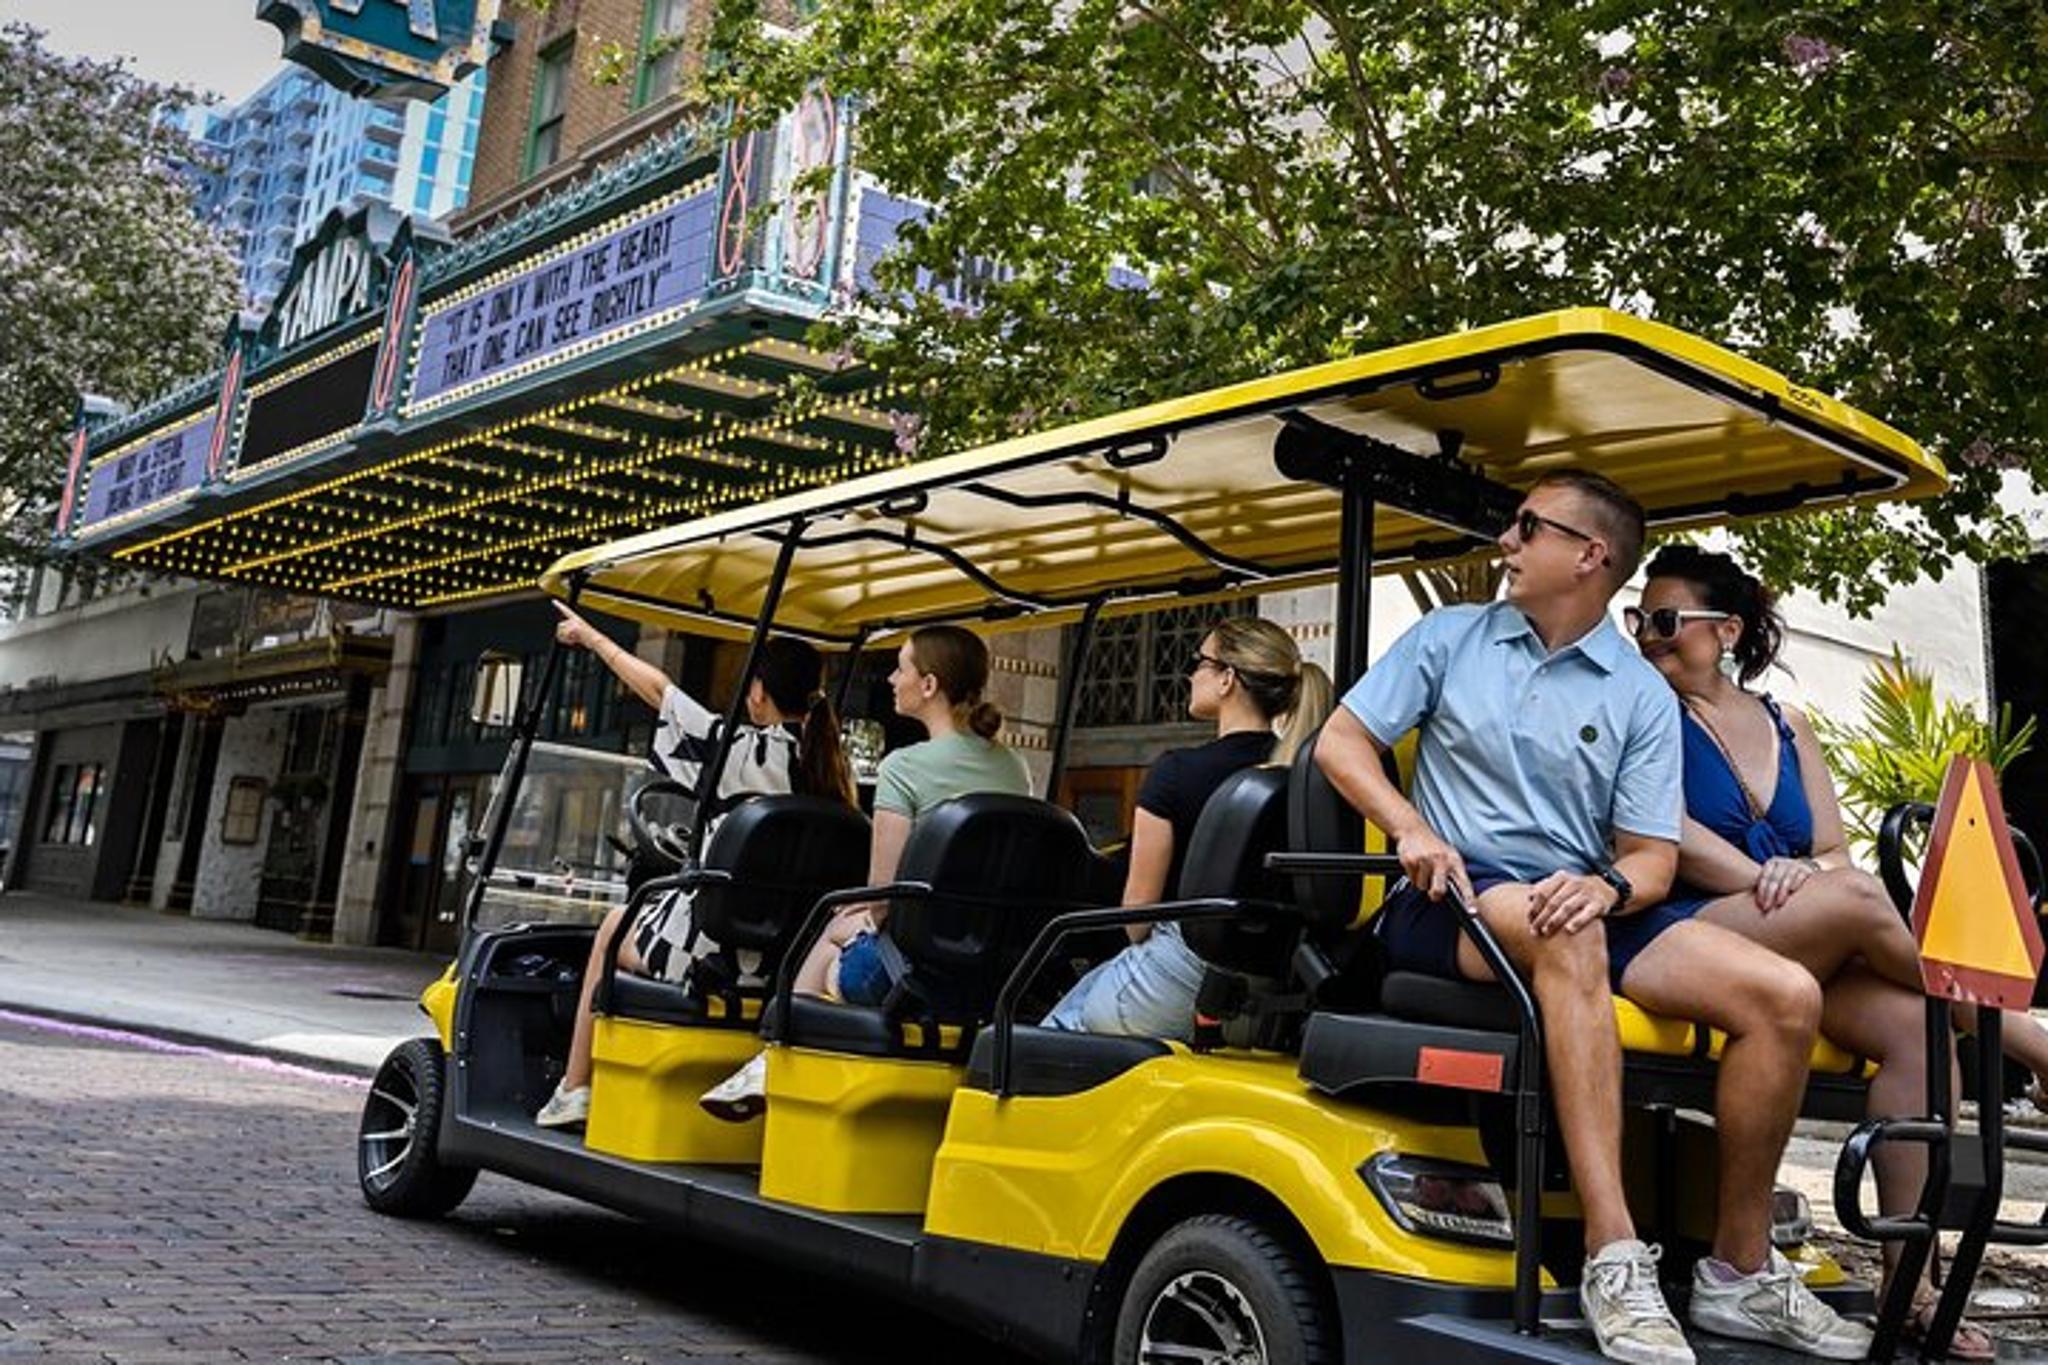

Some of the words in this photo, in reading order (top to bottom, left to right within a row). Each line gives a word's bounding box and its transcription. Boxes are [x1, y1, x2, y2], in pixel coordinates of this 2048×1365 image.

[278, 238, 371, 349] TAMPA
[469, 301, 484, 337] IS
[489, 281, 528, 327] ONLY
[534, 262, 573, 310] WITH
[580, 244, 610, 290] THE
[617, 215, 675, 274] HEART
[442, 342, 477, 388] THAT
[480, 329, 510, 371] ONE
[514, 313, 547, 358] CAN
[552, 299, 584, 344] SEE
